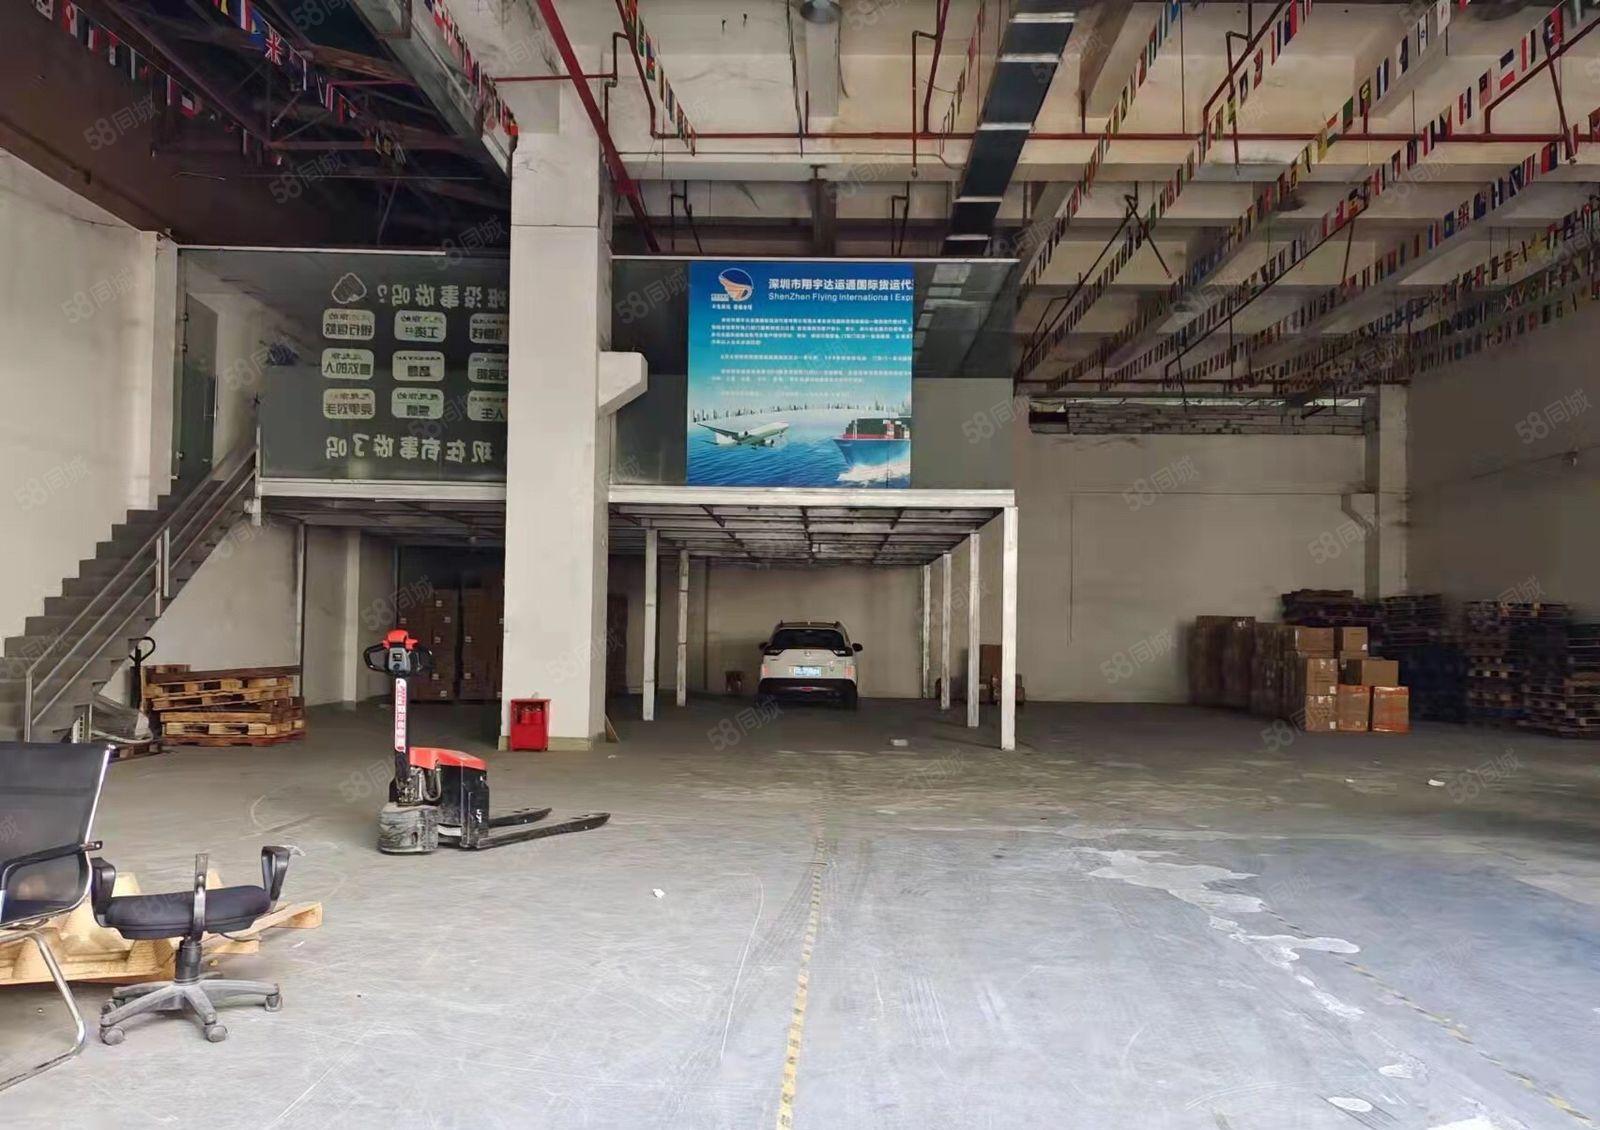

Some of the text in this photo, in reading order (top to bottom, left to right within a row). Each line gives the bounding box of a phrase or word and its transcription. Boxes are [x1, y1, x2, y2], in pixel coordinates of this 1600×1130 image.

[768, 278, 913, 291] 深圳市翔宇达运通国际货运代
[812, 293, 838, 303] Flying
